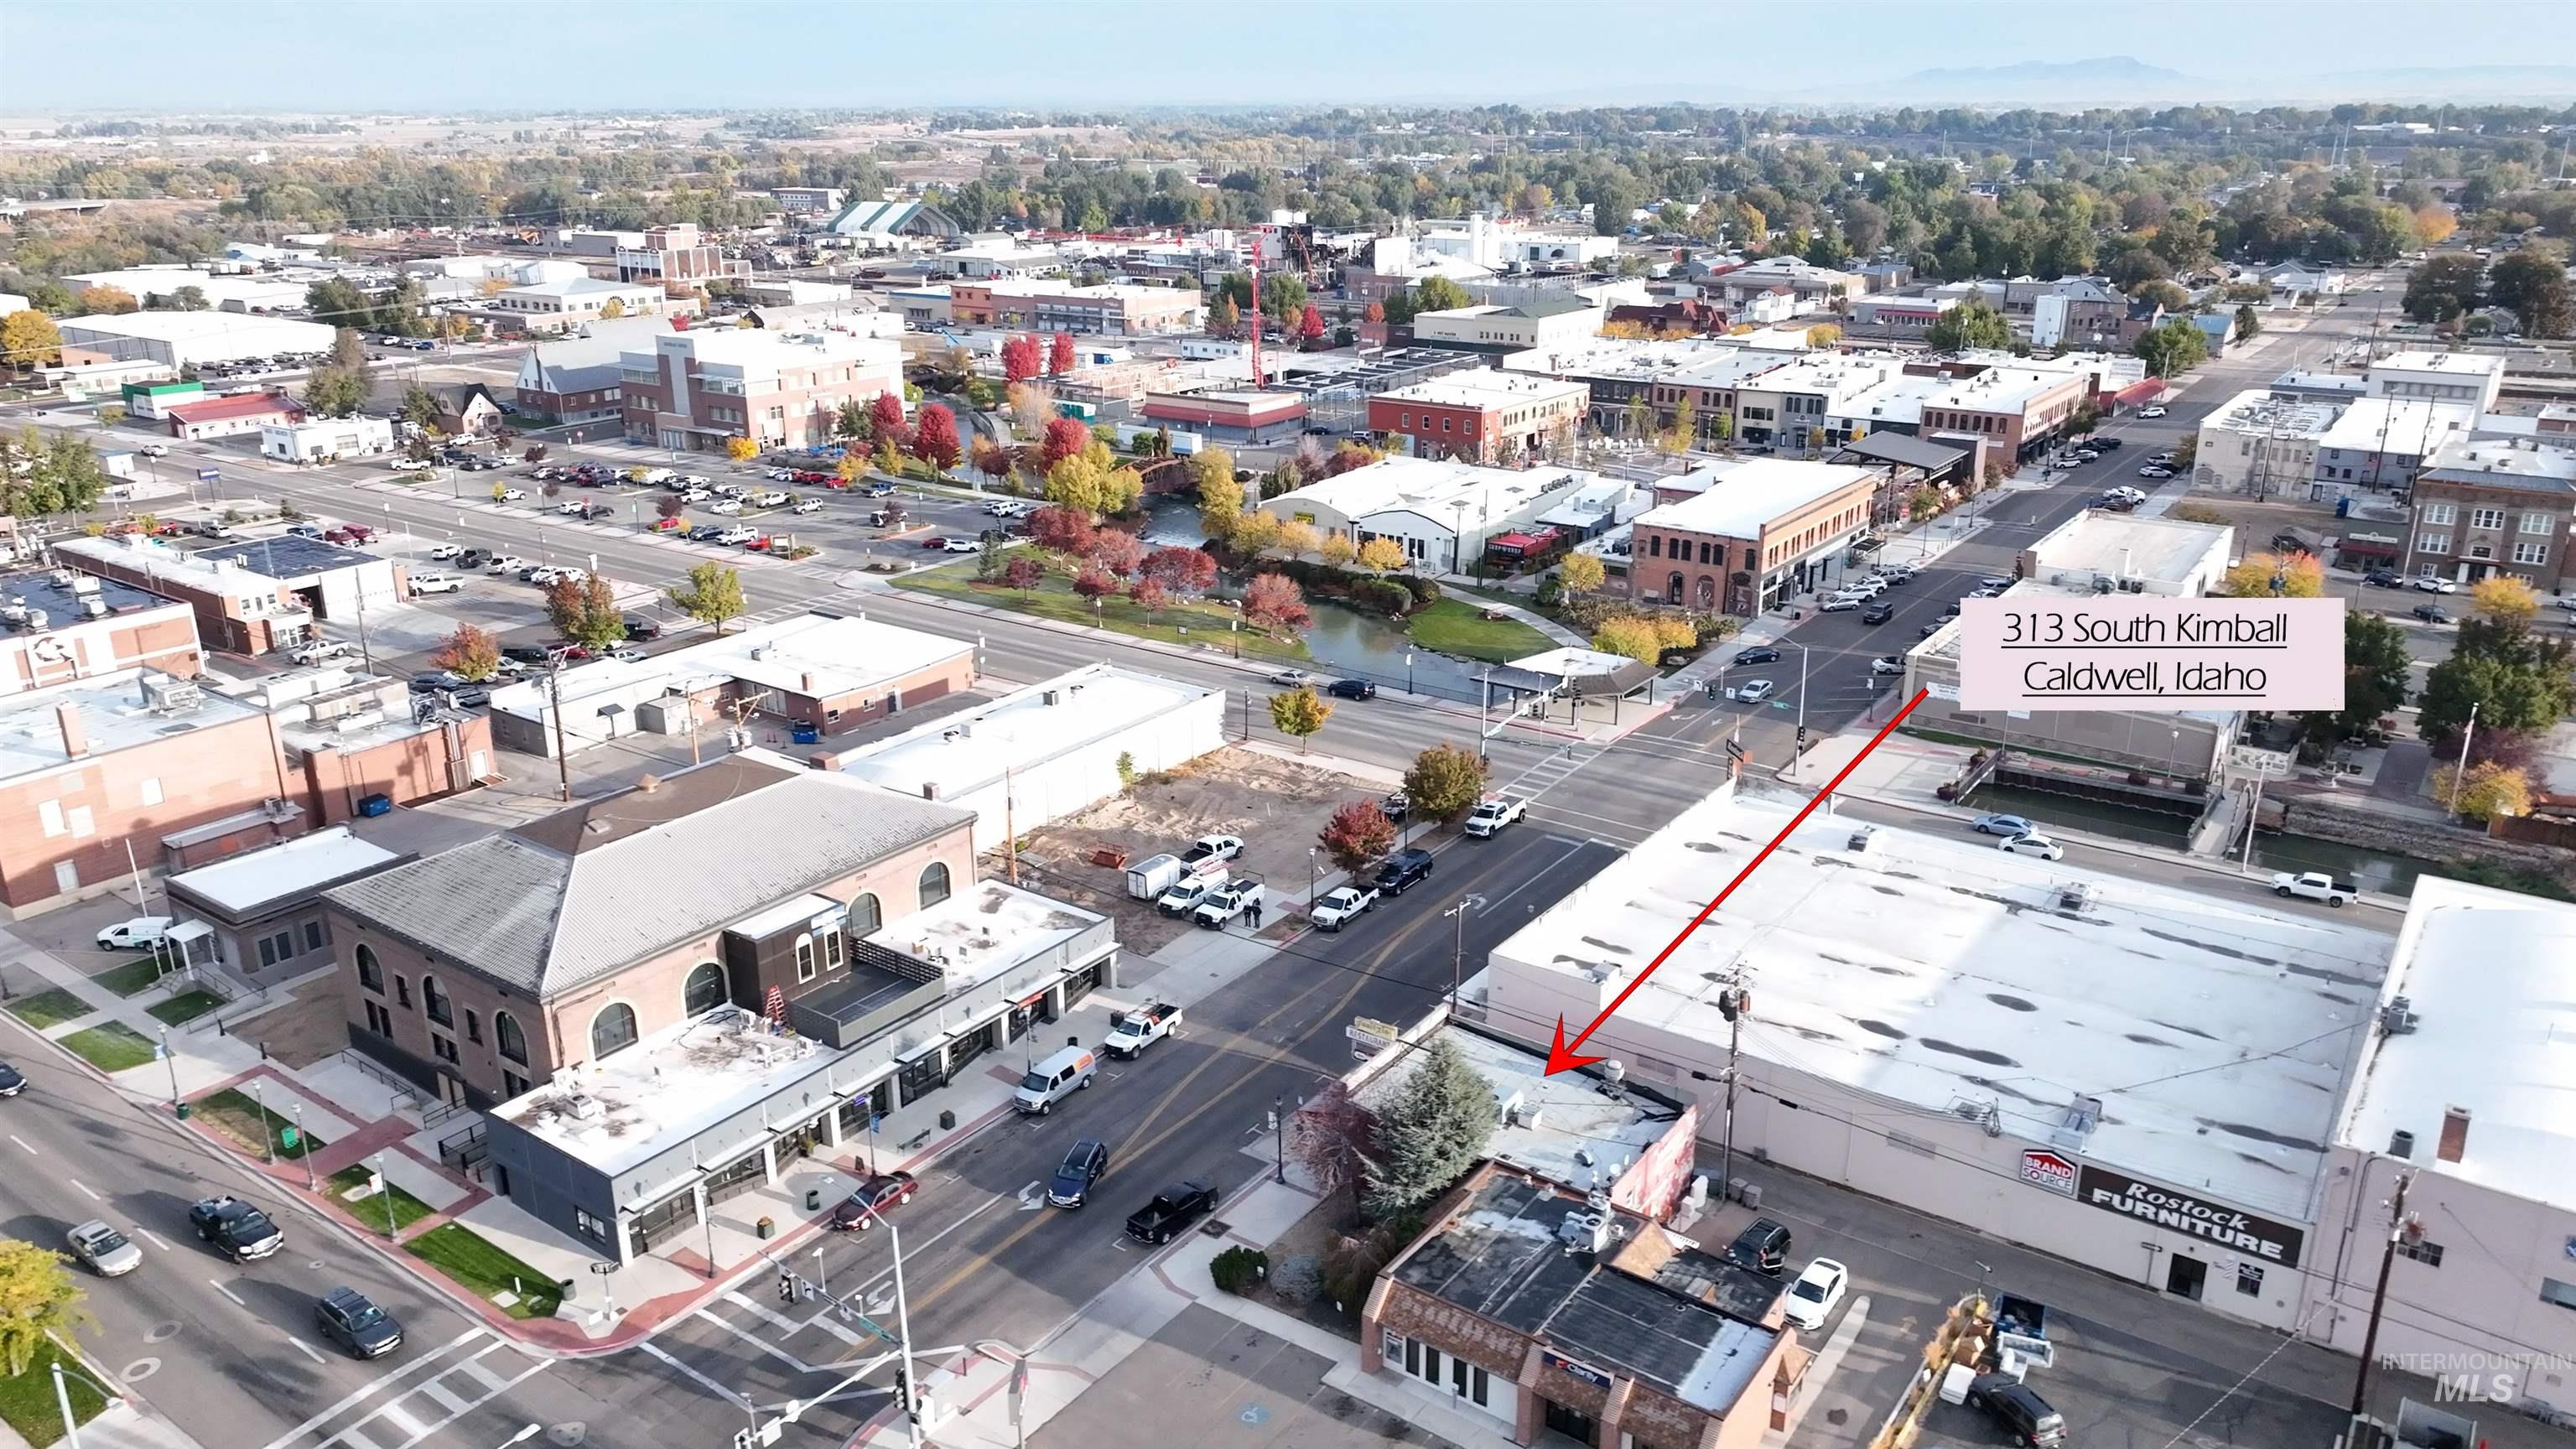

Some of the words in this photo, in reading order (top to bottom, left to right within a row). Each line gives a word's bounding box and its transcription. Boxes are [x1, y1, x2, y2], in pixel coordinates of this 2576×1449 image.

[1348, 1029, 1390, 1047] RESTAURANT
[2023, 1167, 2071, 1190] SOURCE
[2025, 1156, 2071, 1178] BRAND
[2126, 1182, 2251, 1230] Rostock
[2092, 1187, 2284, 1259] FURNITURE
